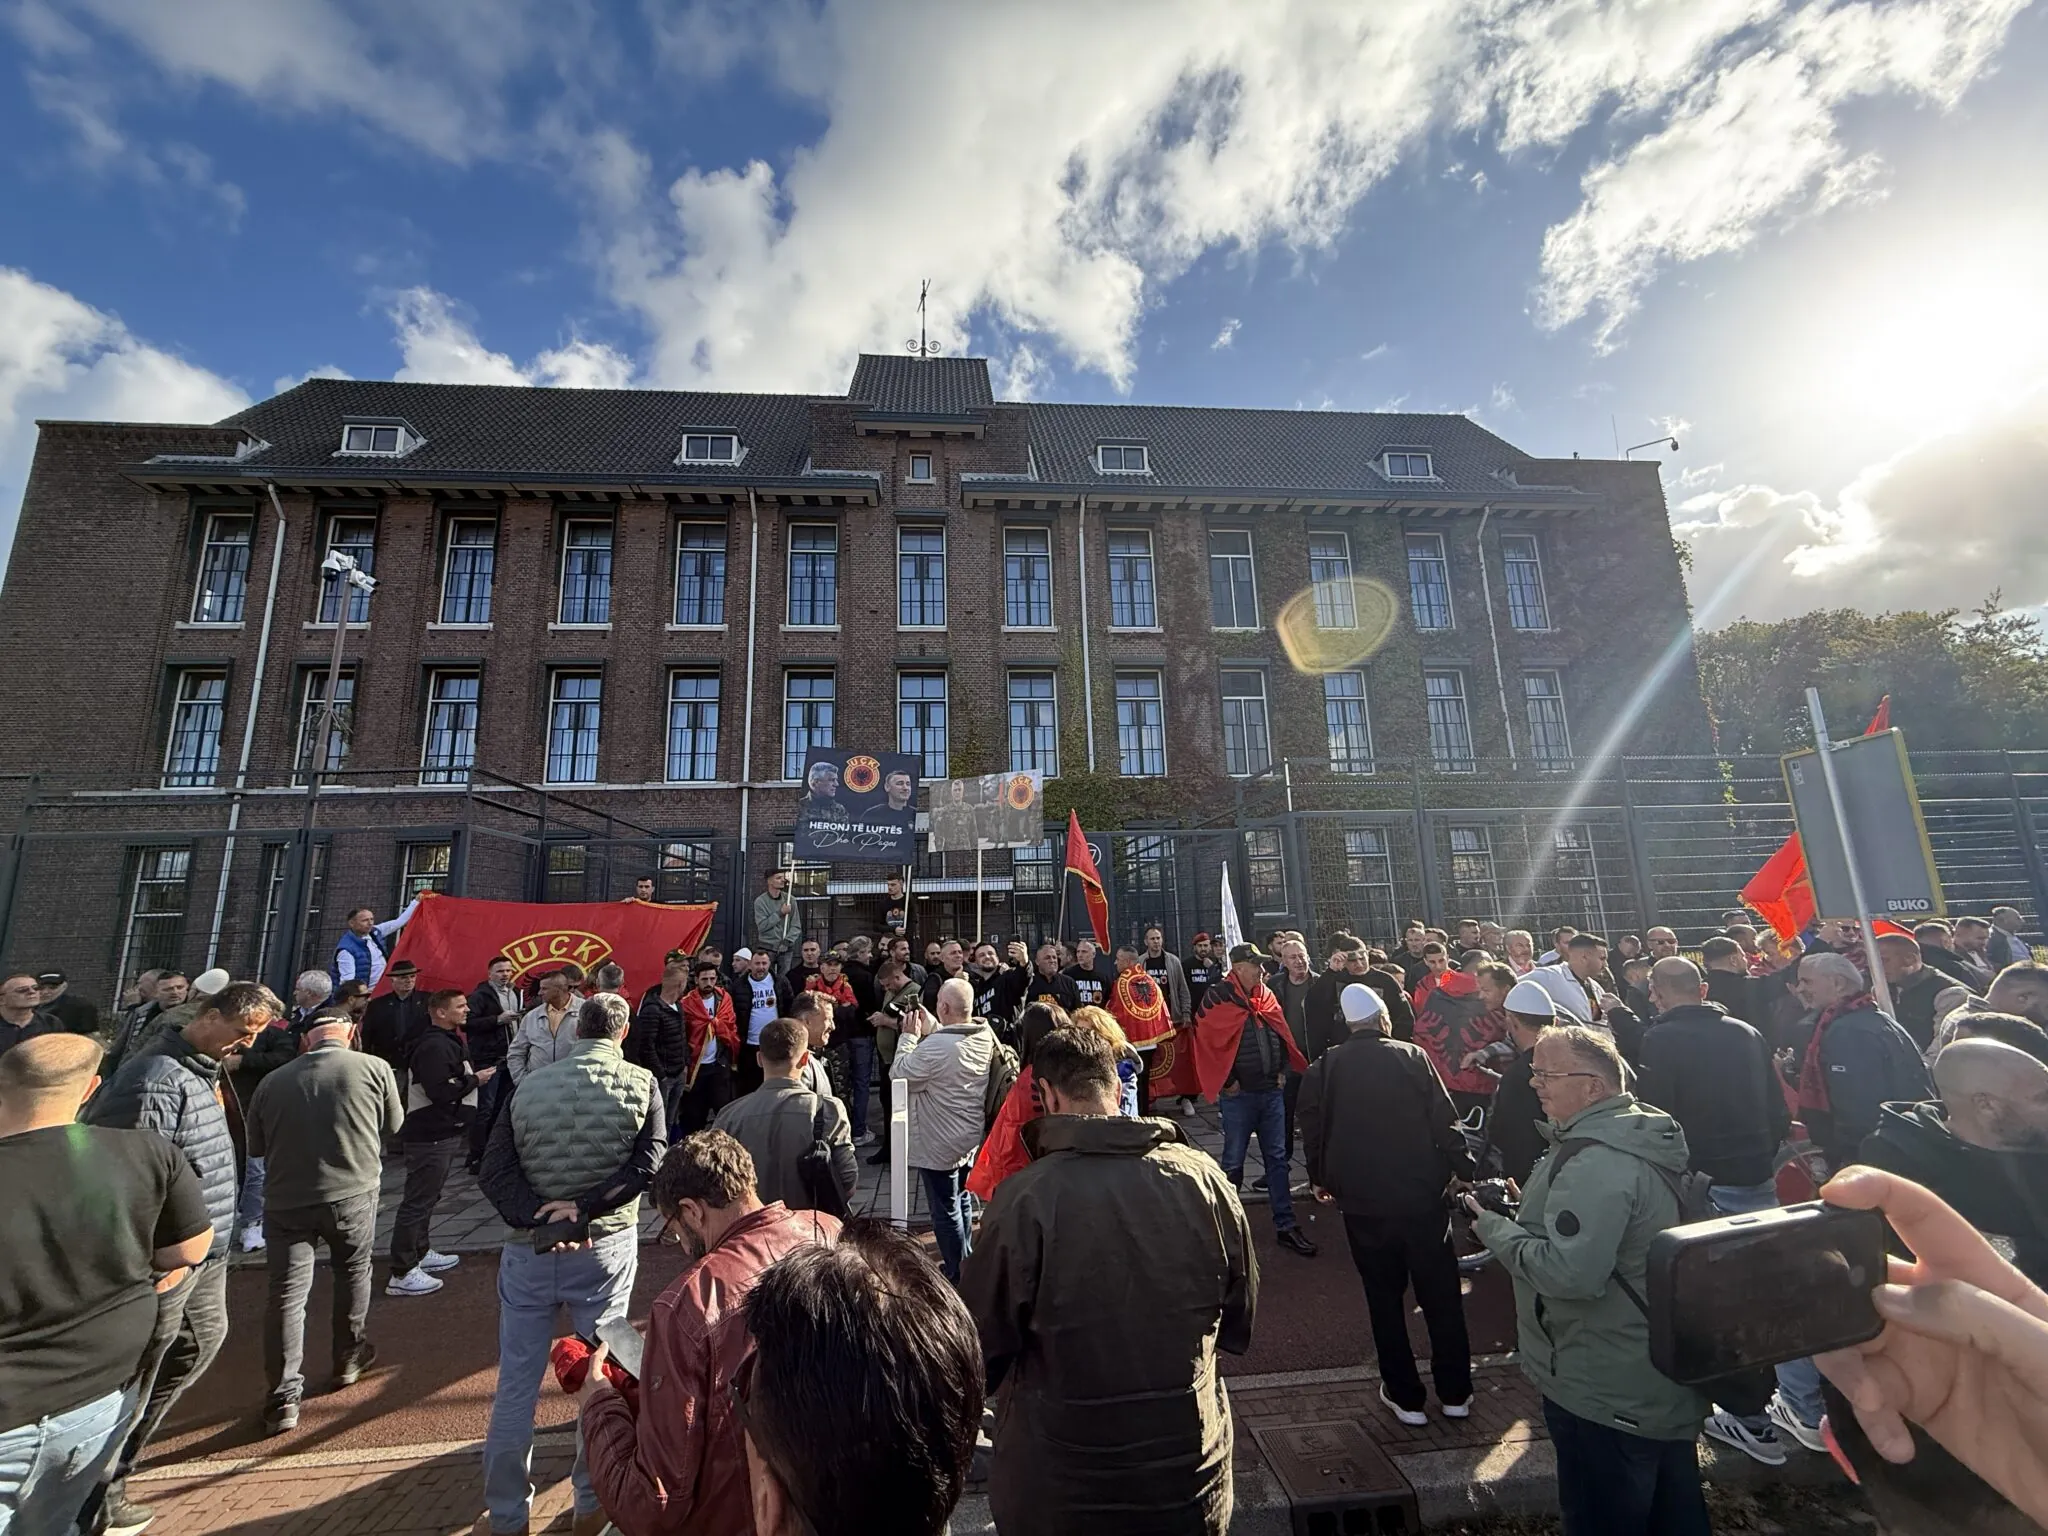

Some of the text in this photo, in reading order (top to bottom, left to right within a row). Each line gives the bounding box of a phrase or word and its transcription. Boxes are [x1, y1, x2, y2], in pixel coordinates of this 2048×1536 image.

[809, 821, 903, 835] HERONJ TË LUFTËS
[808, 829, 849, 849] Dhe
[1887, 899, 1930, 912] BUKO
[513, 935, 601, 964] UÇK
[1092, 980, 1103, 992] KA
